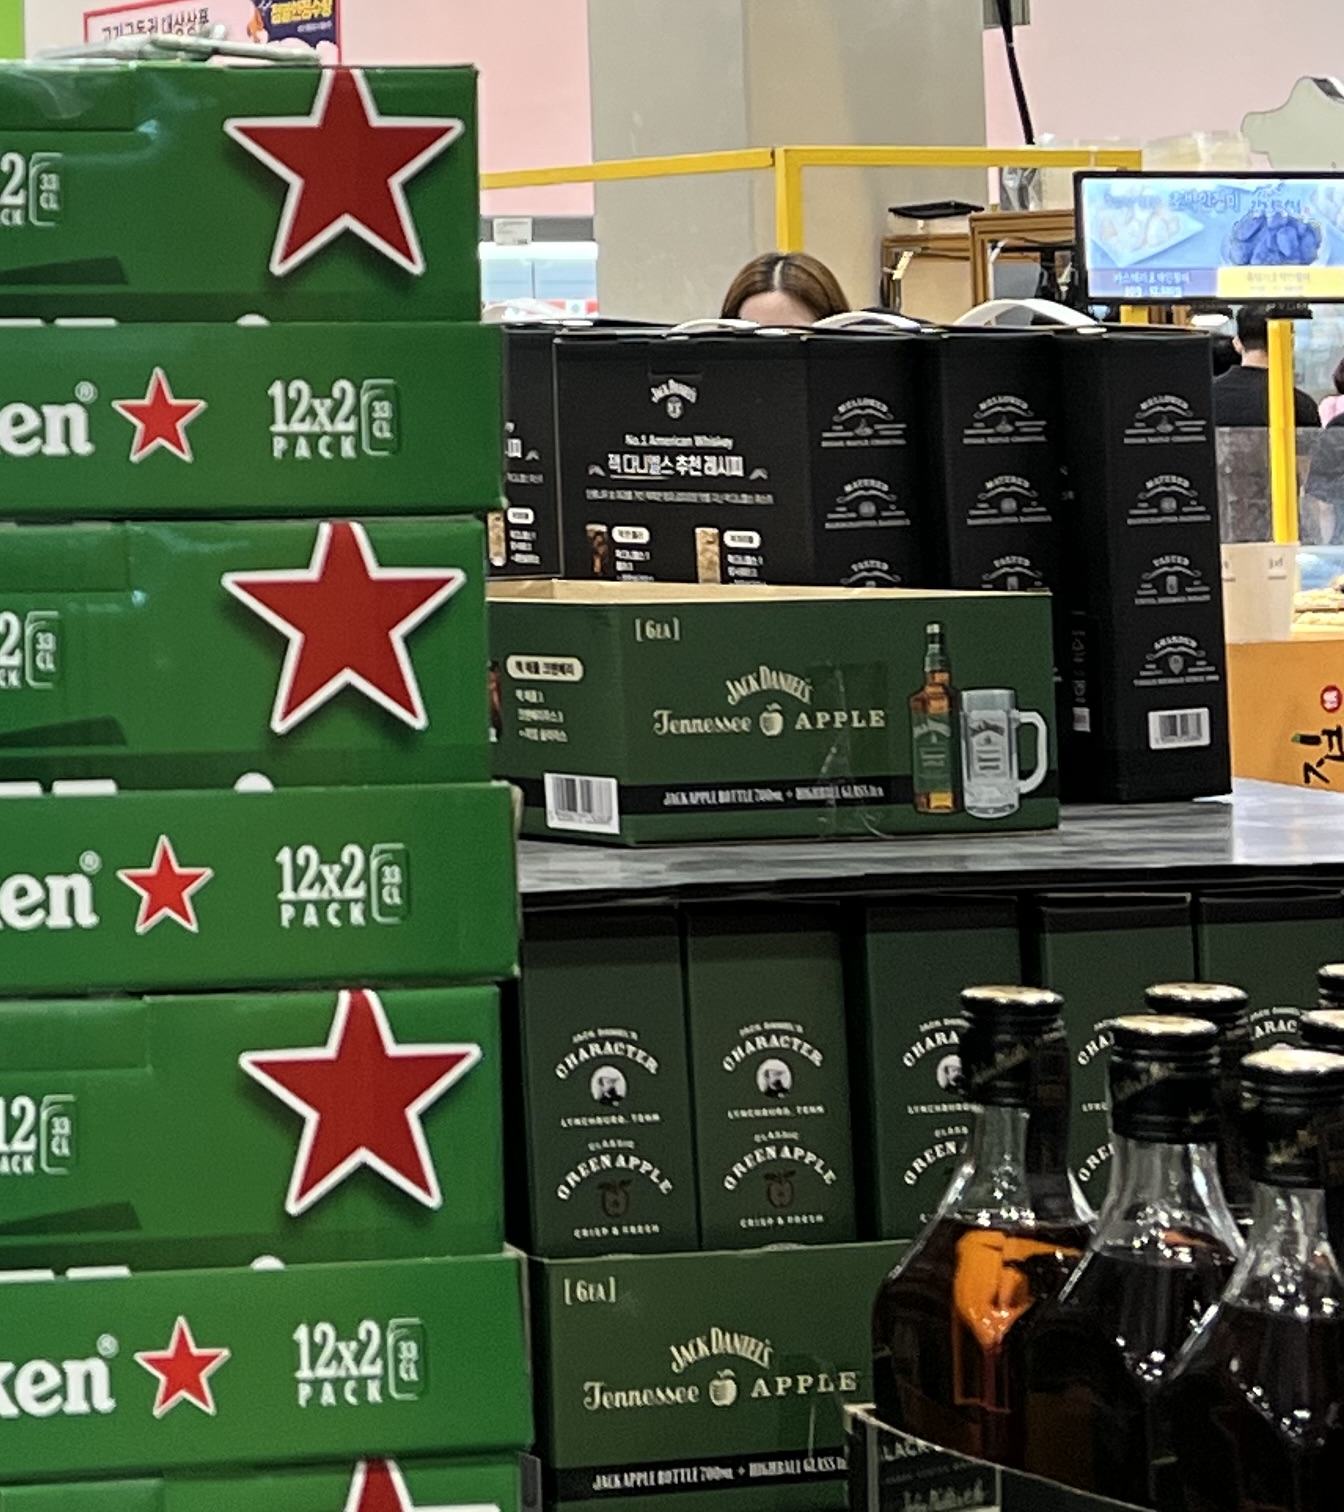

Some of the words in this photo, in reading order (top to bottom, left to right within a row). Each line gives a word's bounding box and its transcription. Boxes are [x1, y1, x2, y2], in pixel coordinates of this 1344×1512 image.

[267, 379, 359, 436] 12x2
[273, 436, 357, 459] PACK
[675, 454, 702, 477] 추천
[726, 672, 759, 705] JACK
[652, 709, 752, 736] Tennessee
[795, 710, 886, 732] APPLE
[275, 843, 367, 901] 12x2
[281, 904, 366, 928] PACK
[554, 1040, 659, 1080] CHARACTER
[722, 1034, 824, 1072] CHARACTER
[556, 1154, 613, 1200] GREEN
[615, 1153, 673, 1195] APPLE
[723, 1146, 777, 1192] GREEN
[779, 1145, 837, 1186] APPLE
[293, 1320, 384, 1380] 12x2
[670, 1336, 711, 1374] JACK
[298, 1380, 383, 1408] PACK
[583, 1381, 700, 1410] Tennessee
[750, 1371, 858, 1398] APPLE
[623, 1471, 655, 1488] APPLE
[657, 1468, 698, 1486] BOTTLE
